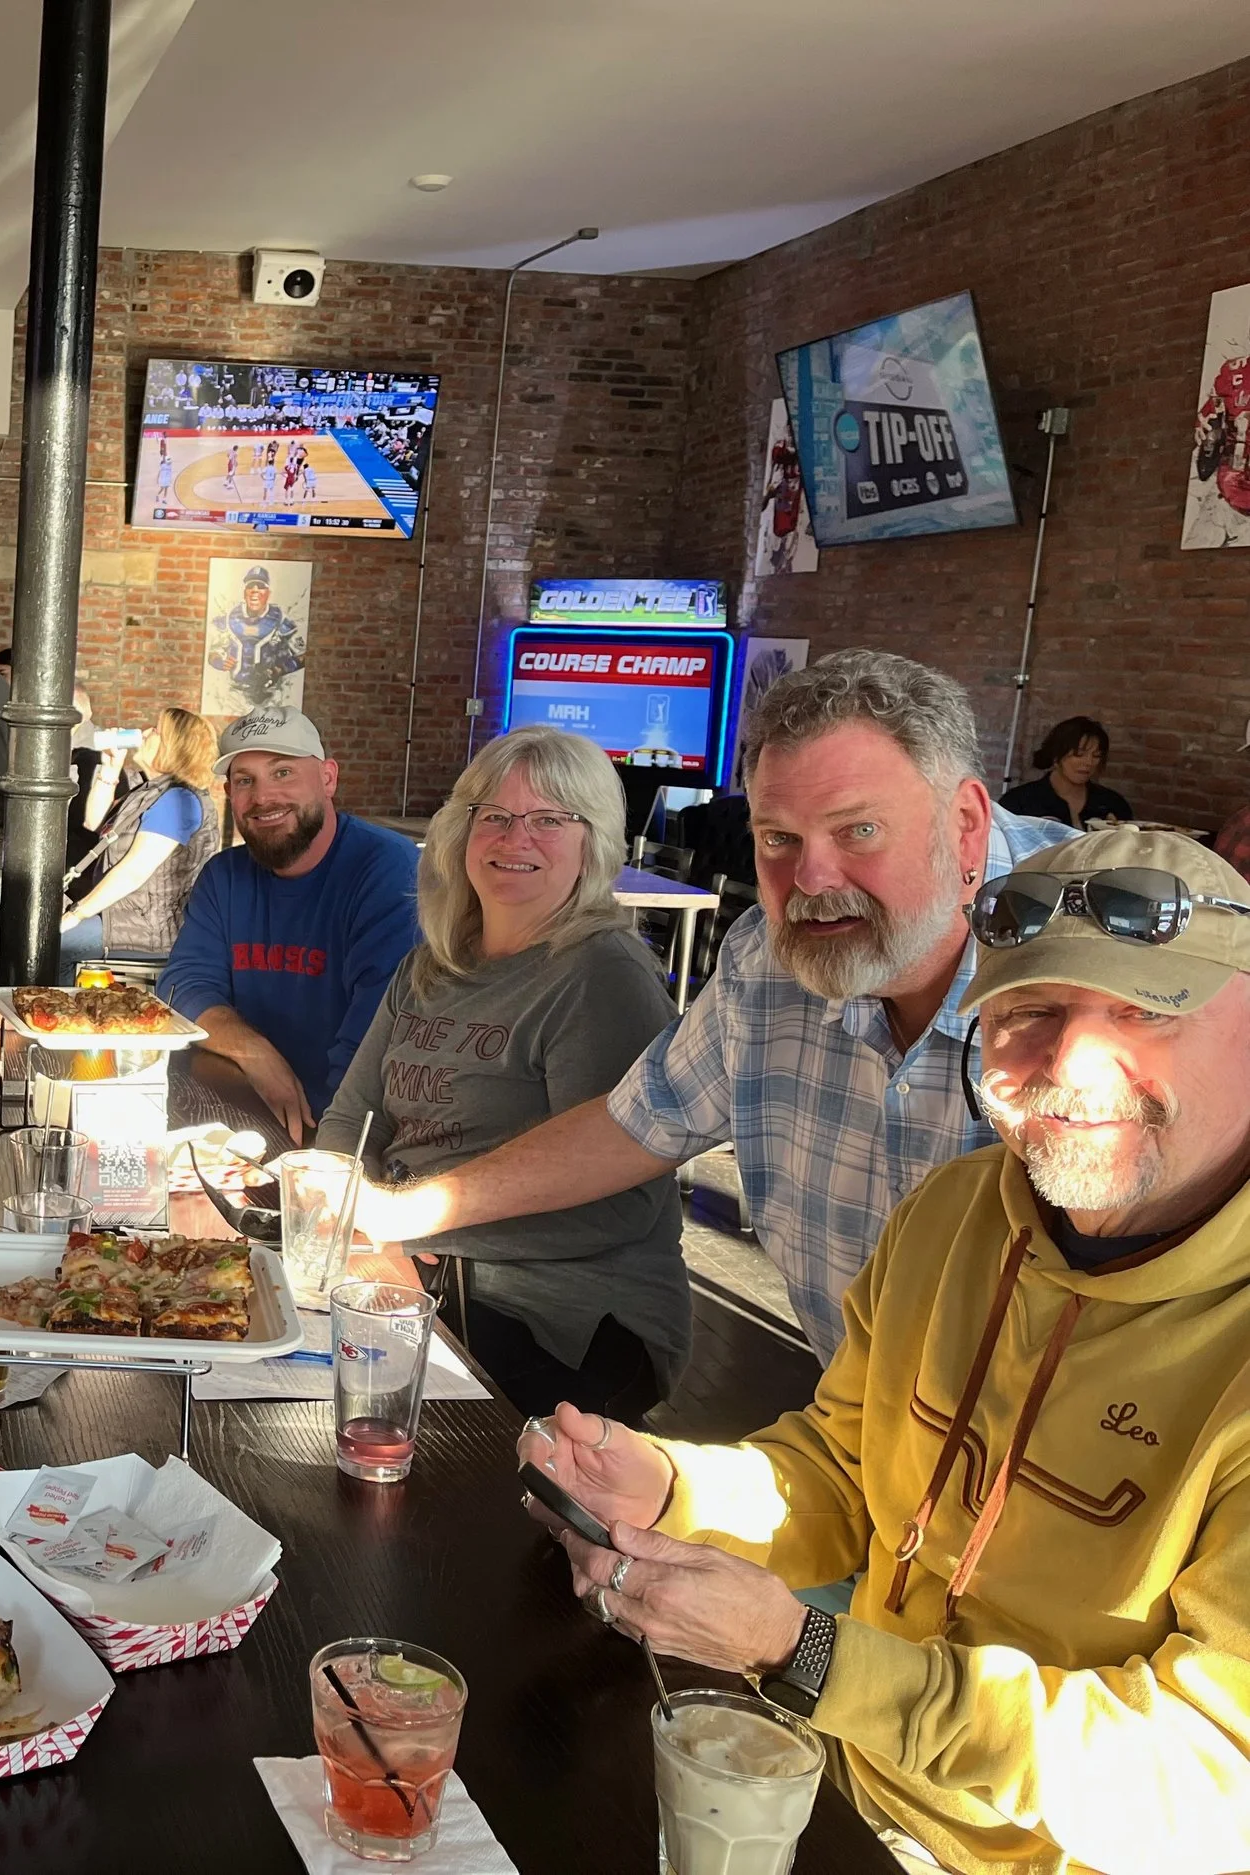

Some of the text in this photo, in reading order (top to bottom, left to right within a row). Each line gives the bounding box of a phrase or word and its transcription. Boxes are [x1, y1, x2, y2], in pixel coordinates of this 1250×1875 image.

[862, 410, 955, 465] TIP-OFF
[538, 589, 693, 613] GOLDEN TEE
[519, 652, 707, 676] COURSE CHAMP
[240, 723, 270, 741] Hill
[455, 1022, 510, 1061] TO
[389, 1059, 460, 1104] WINE
[1100, 1402, 1160, 1446] Leo
[44, 1491, 72, 1505] Crushed
